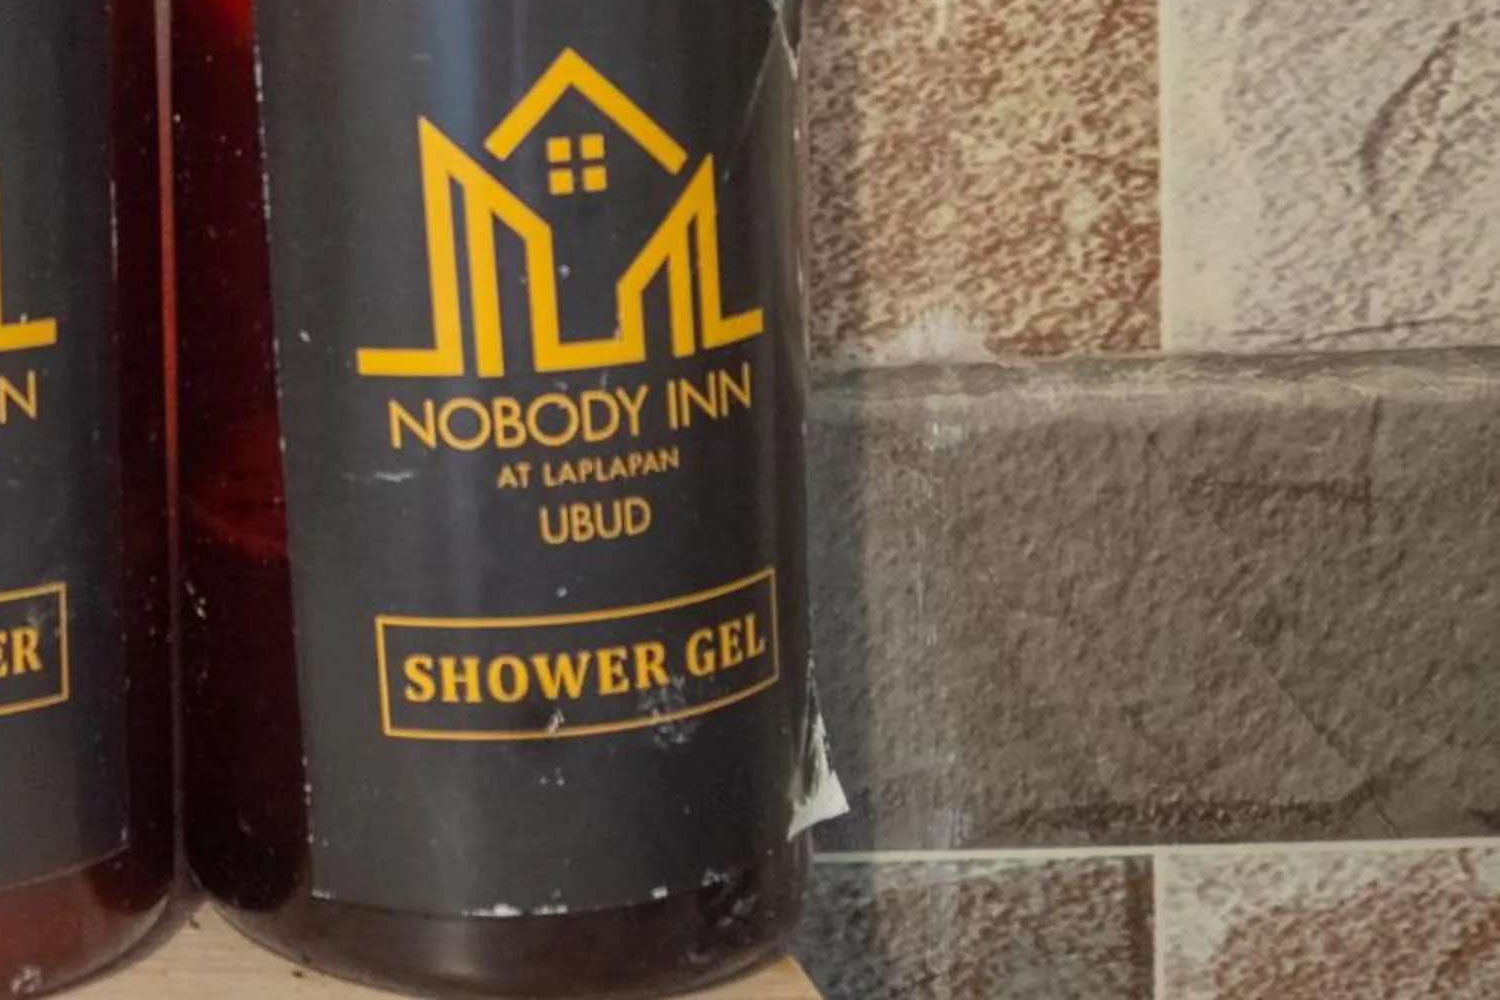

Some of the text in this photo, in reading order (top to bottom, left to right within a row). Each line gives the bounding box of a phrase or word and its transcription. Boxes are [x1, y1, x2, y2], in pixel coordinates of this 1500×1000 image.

[388, 363, 751, 451] NOBODY INN
[497, 446, 680, 489] AT LAPLAPAN
[539, 497, 652, 544] UBUD
[403, 613, 766, 703] SHOWER GEL
